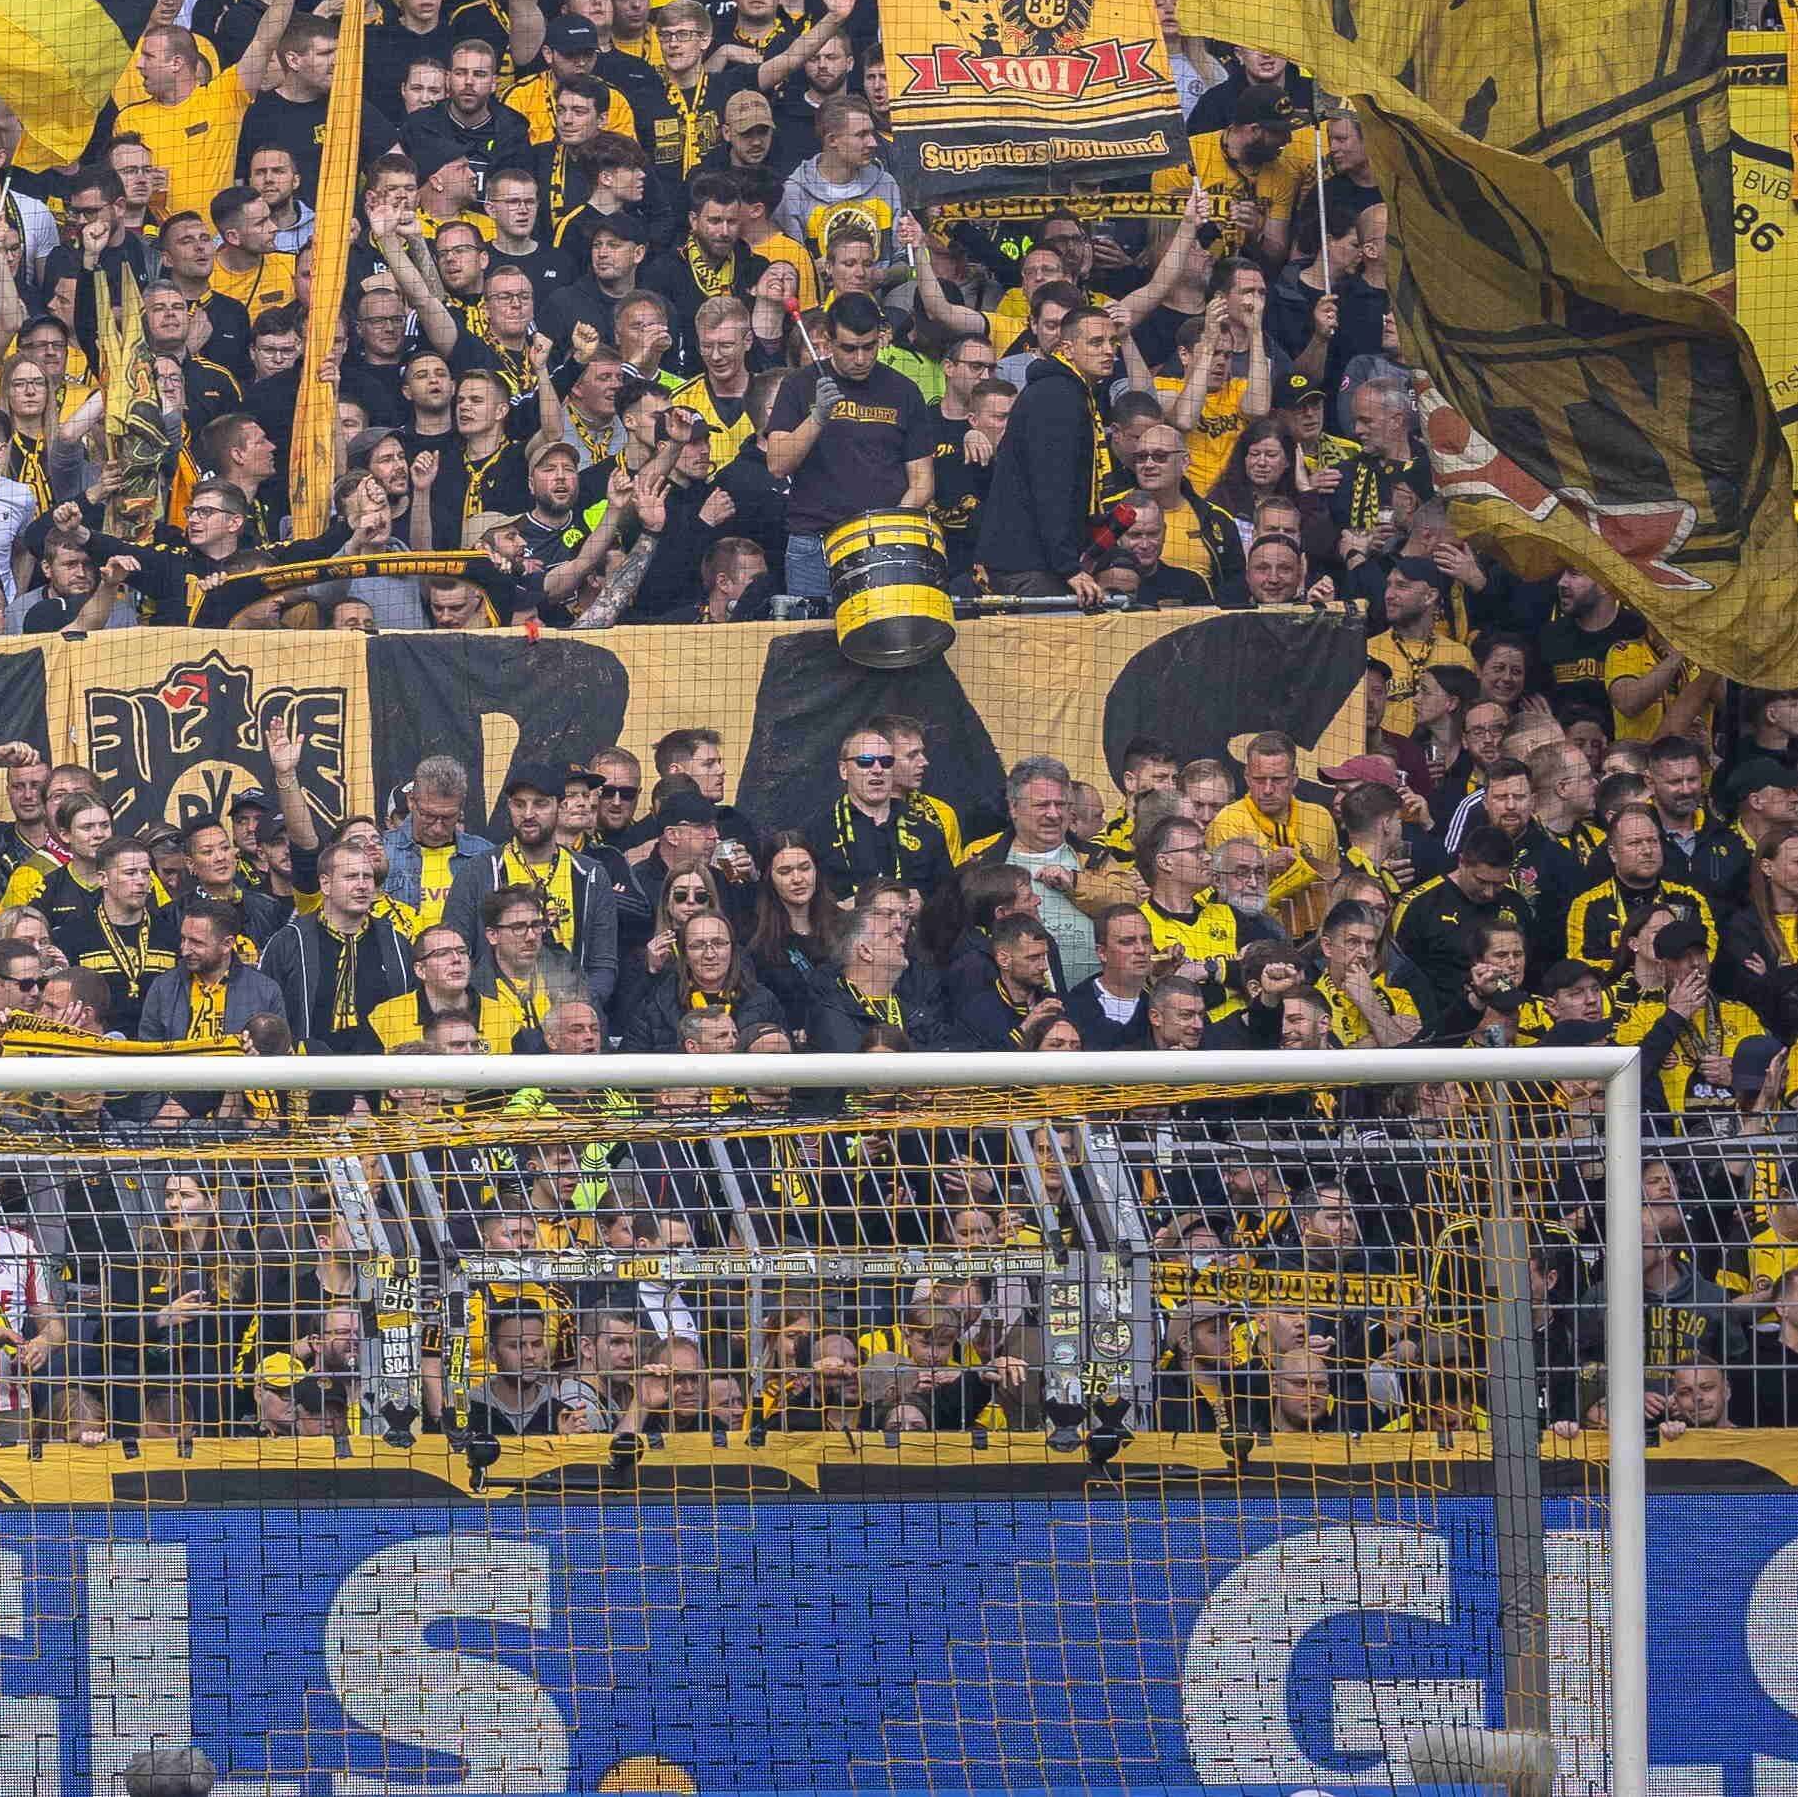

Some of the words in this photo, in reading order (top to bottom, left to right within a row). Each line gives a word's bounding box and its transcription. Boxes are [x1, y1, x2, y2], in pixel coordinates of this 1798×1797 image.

[983, 54, 1079, 96] 2001
[920, 140, 1049, 173] Supporters
[1050, 131, 1170, 163] Dortmund
